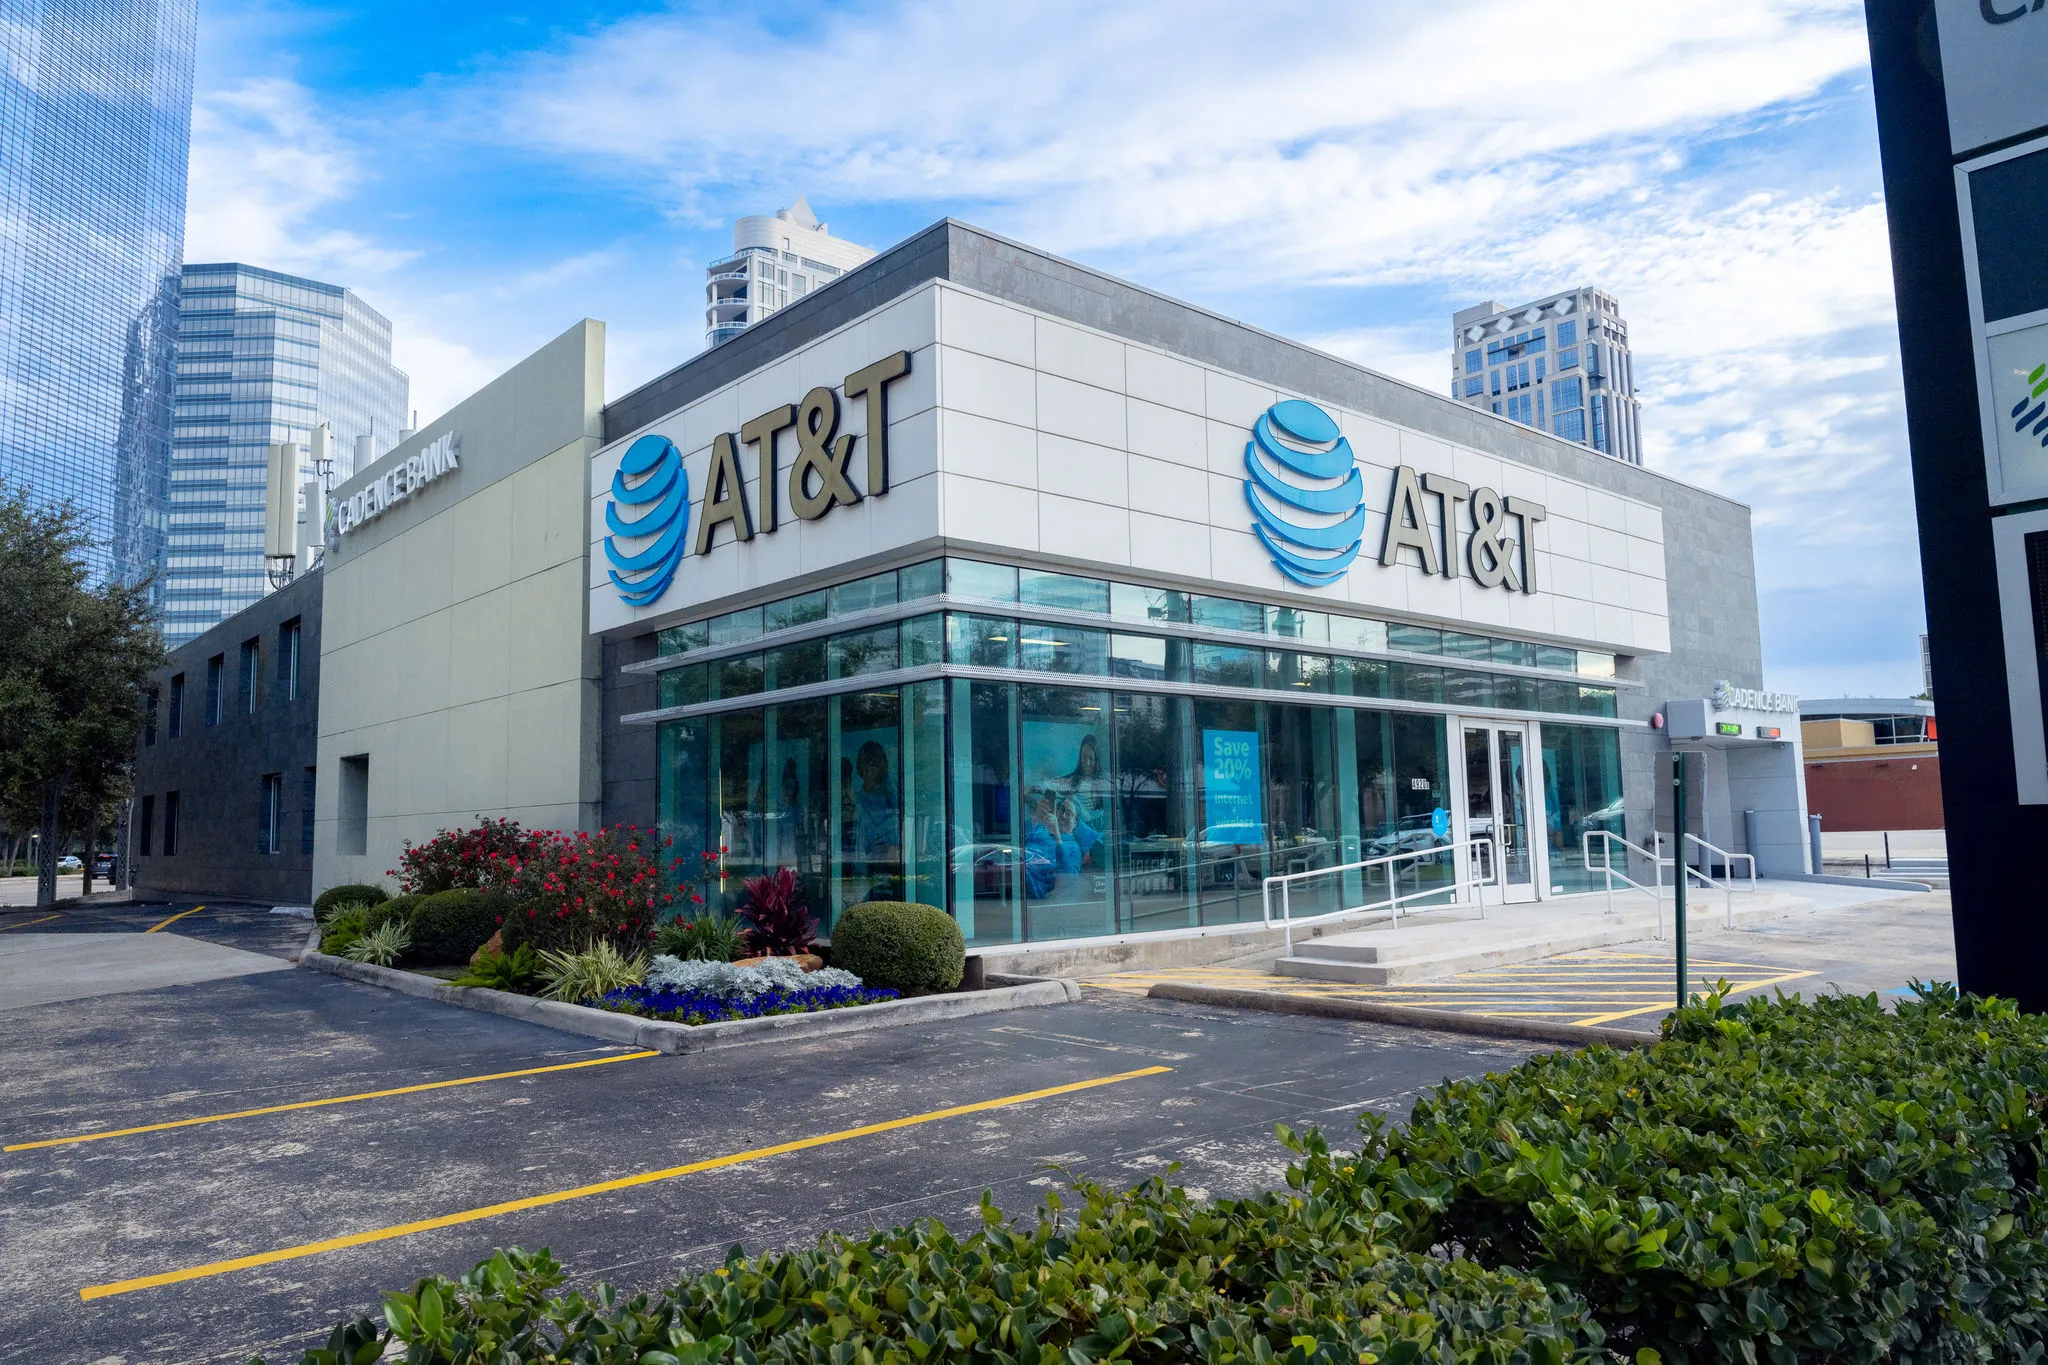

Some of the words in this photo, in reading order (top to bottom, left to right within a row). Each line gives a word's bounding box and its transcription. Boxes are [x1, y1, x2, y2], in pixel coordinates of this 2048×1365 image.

[338, 461, 408, 535] CADENCE
[406, 430, 460, 494] BANK
[695, 350, 912, 555] AT&T
[1379, 465, 1545, 595] AT&T
[1729, 687, 1773, 711] CADENCE
[1775, 692, 1799, 713] BANK
[1213, 736, 1250, 756] Save
[1213, 758, 1252, 779] 20%
